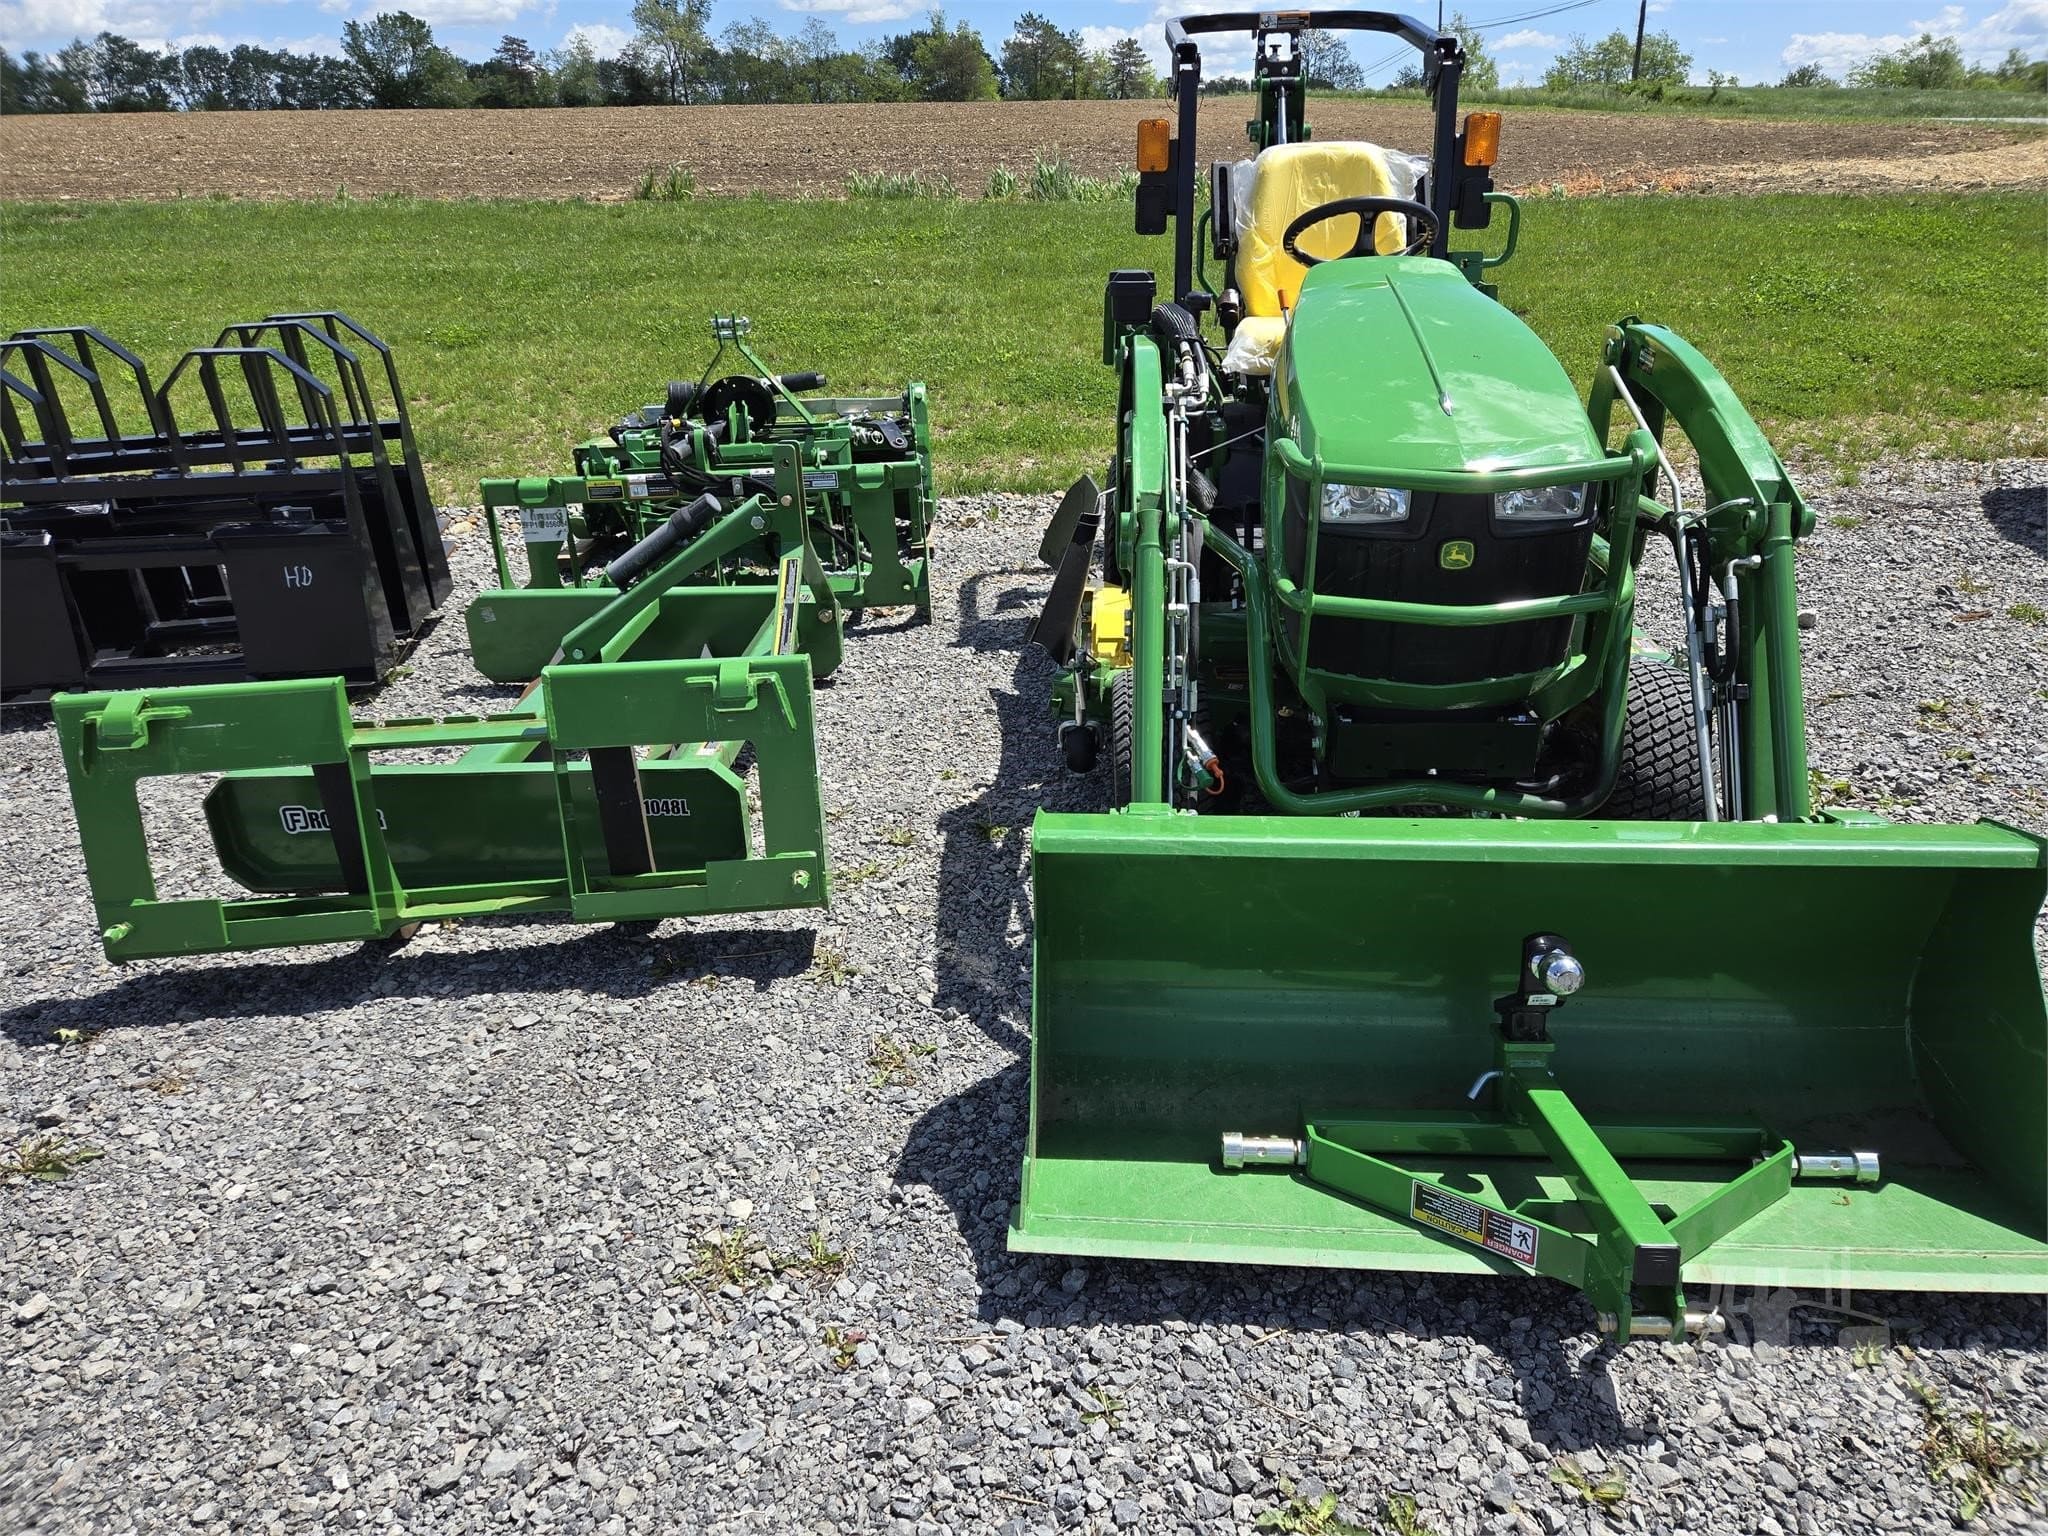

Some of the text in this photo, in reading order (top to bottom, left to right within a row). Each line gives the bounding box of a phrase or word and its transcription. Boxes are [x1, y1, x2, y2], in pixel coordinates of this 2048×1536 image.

[283, 565, 313, 588] HD
[642, 798, 691, 817] 1048L
[1426, 1214, 1461, 1232] CAUTION
[1487, 1238, 1523, 1259] DANGER
